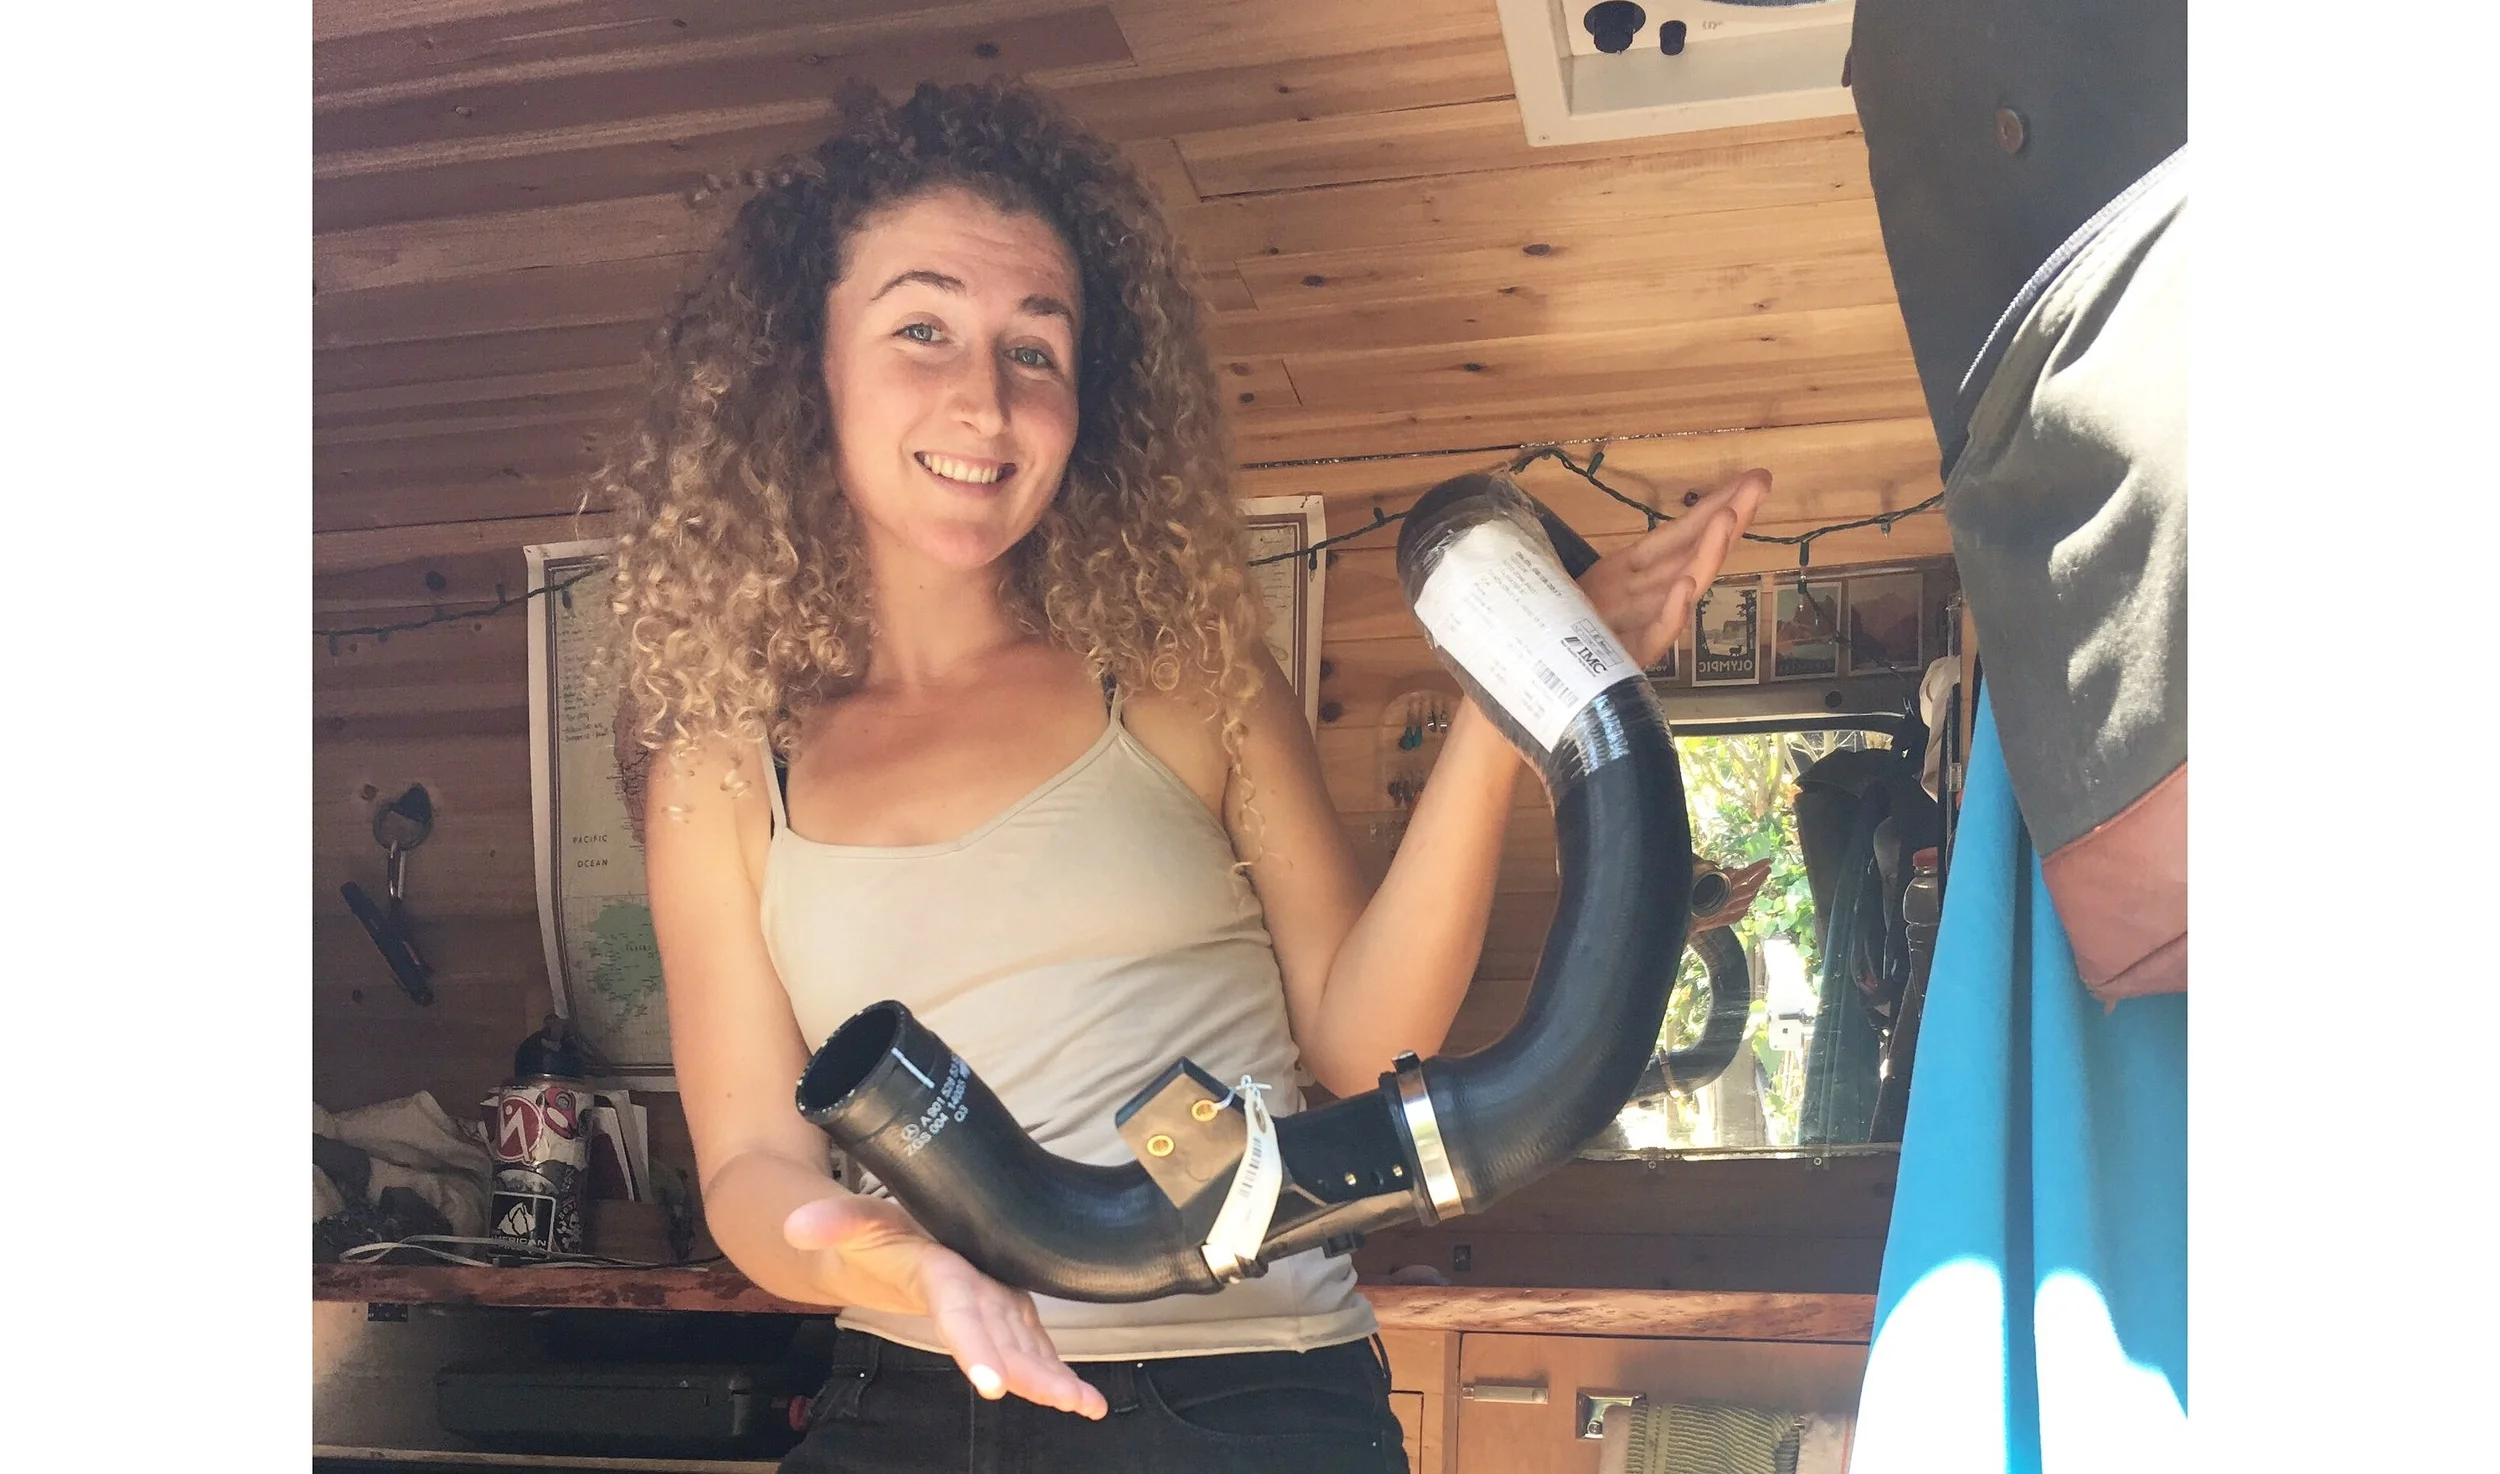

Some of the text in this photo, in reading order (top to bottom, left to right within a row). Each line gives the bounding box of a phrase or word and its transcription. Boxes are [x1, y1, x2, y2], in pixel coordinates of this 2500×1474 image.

[1578, 646, 1608, 674] IMC
[572, 834, 607, 844] PACIFIC
[577, 859, 608, 868] OCEAN
